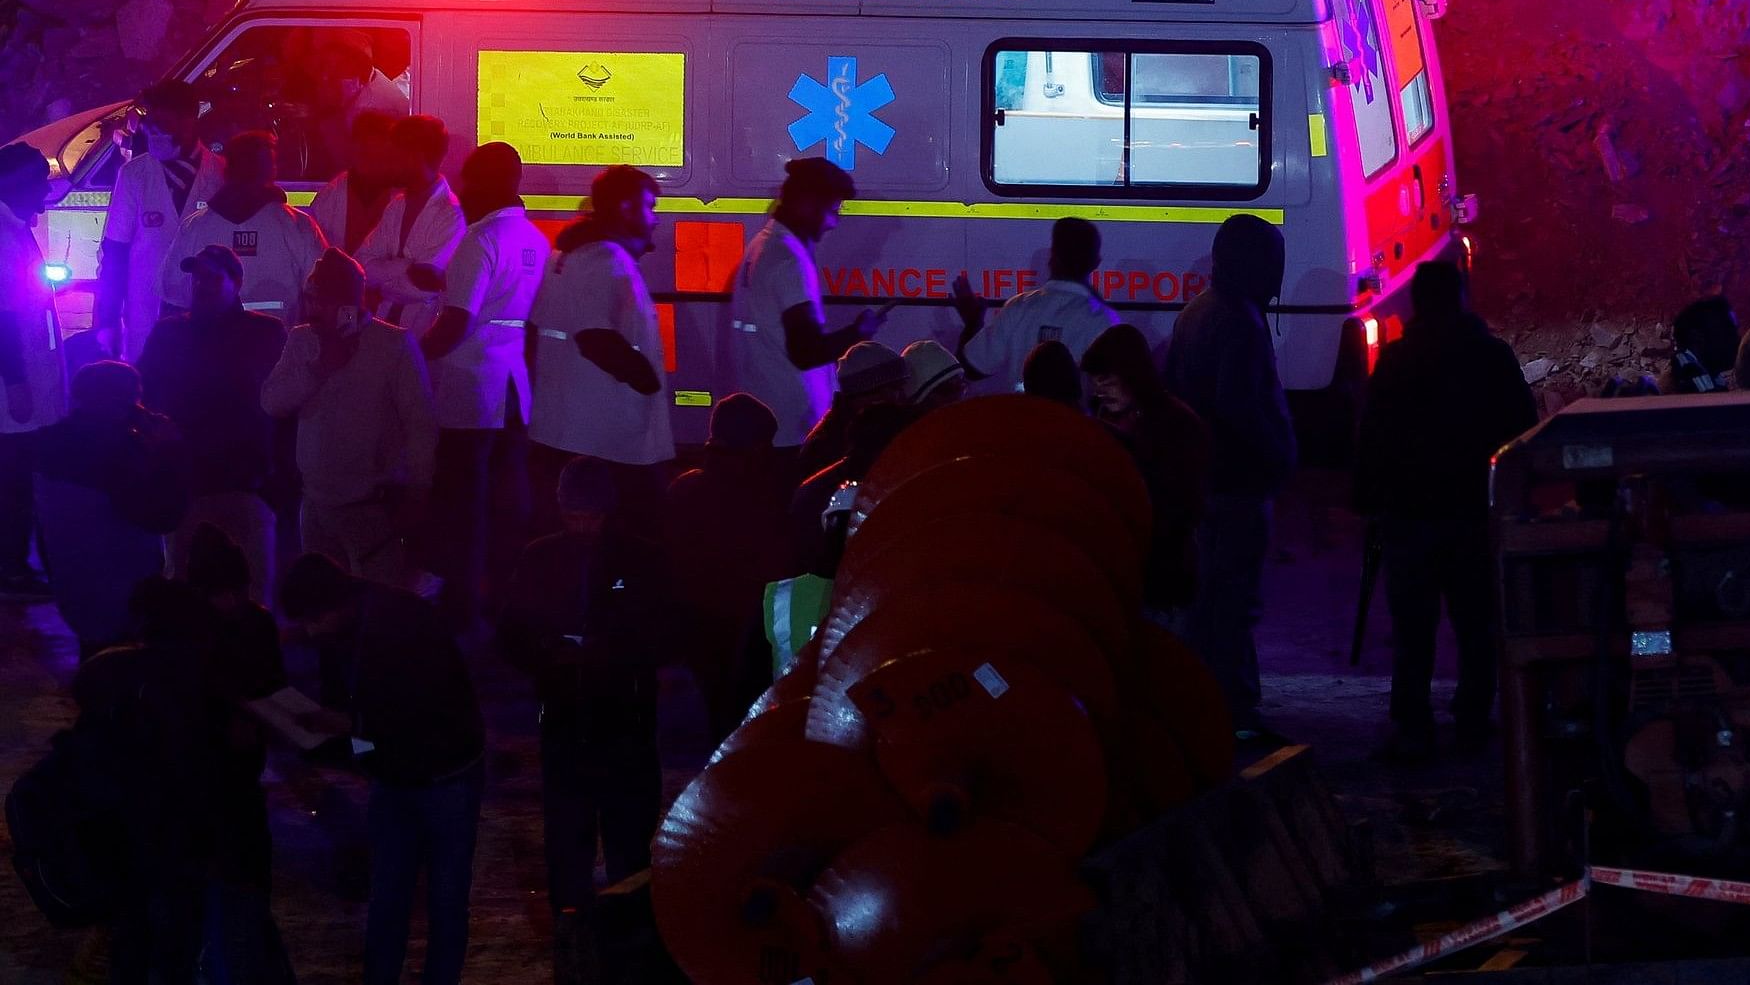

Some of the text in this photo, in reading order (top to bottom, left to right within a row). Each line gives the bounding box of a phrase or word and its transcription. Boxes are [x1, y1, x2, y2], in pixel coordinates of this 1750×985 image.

[550, 131, 635, 141] (World Bank Assisted)
[518, 144, 681, 163] MBULANCE SERVICE
[820, 266, 949, 299] VANCE
[1089, 269, 1209, 302] PPOR
